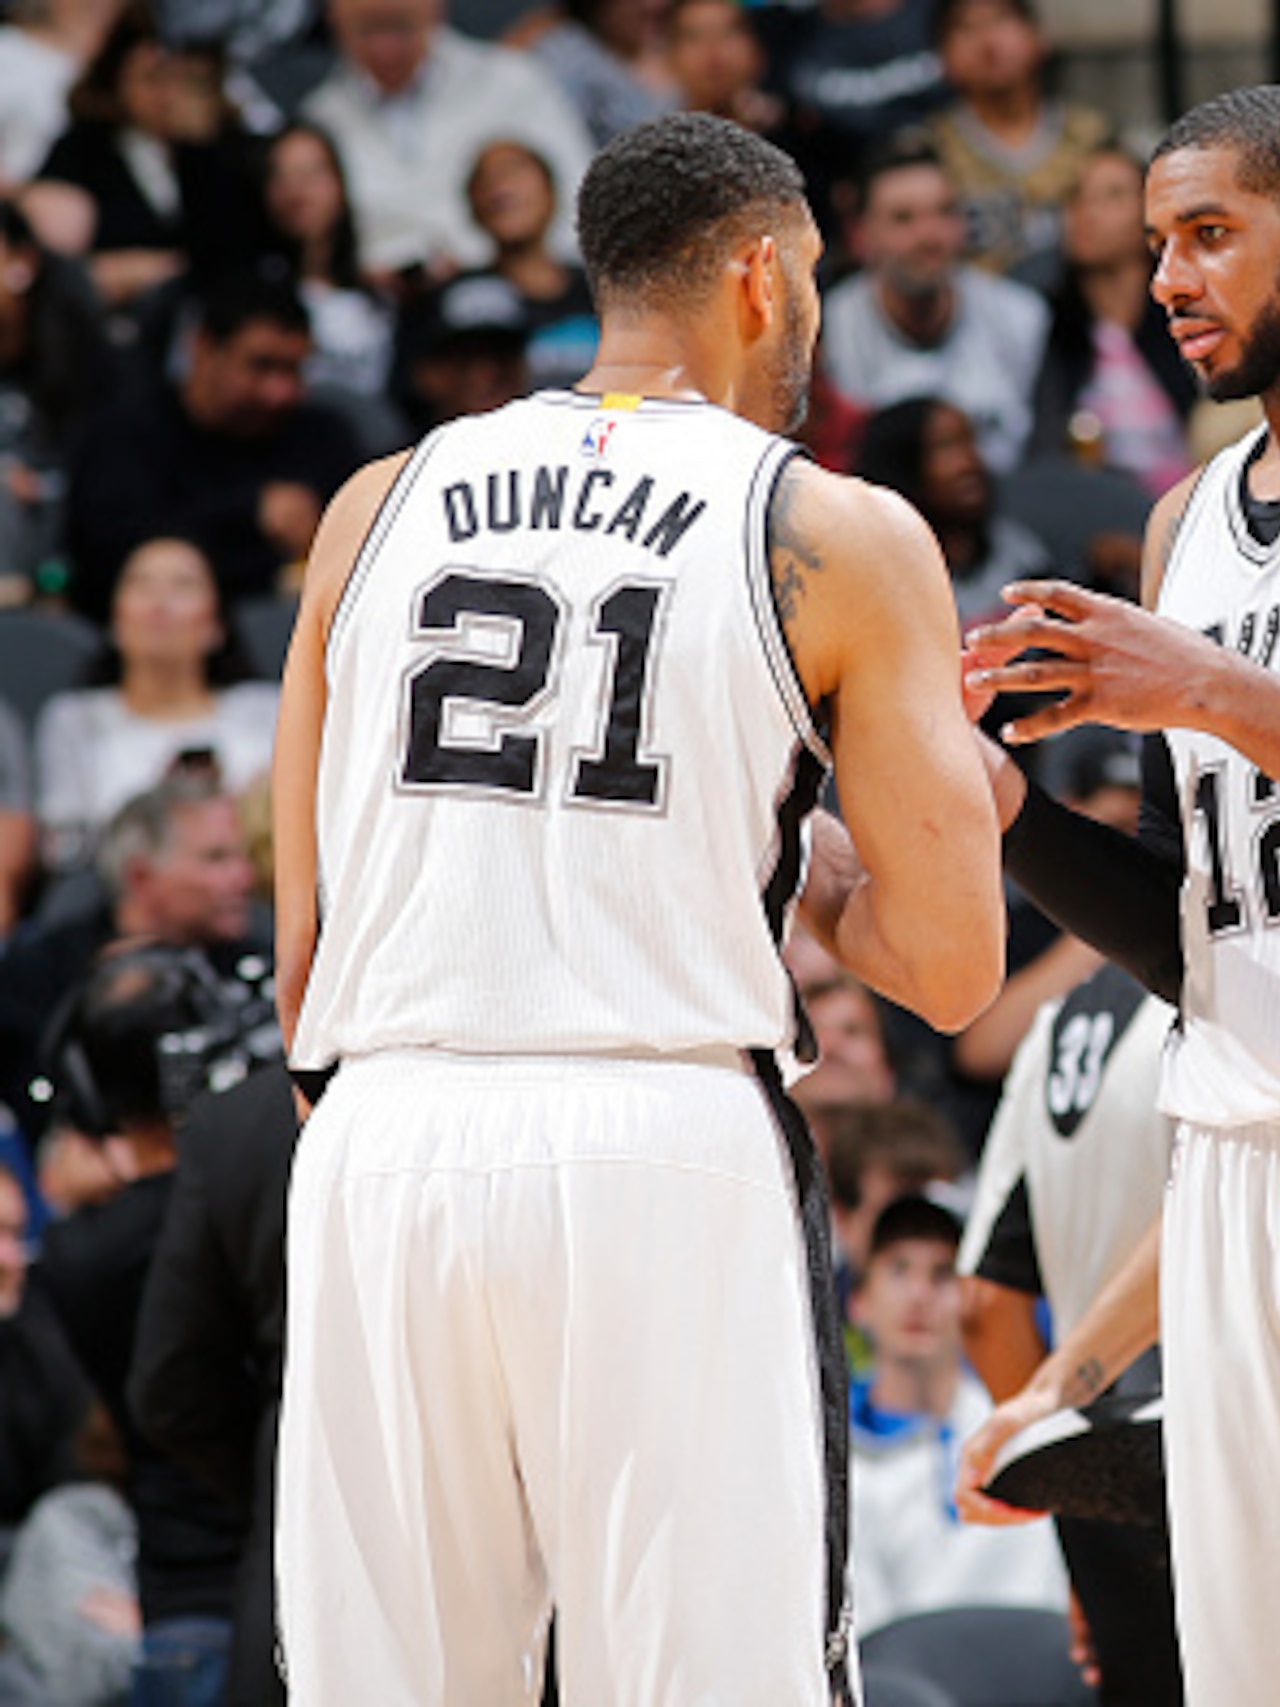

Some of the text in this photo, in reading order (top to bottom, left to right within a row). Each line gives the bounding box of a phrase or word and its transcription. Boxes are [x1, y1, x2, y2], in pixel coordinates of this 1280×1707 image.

[443, 465, 706, 558] DUNCAN
[396, 567, 673, 816] 21
[1051, 1011, 1114, 1115] 33
